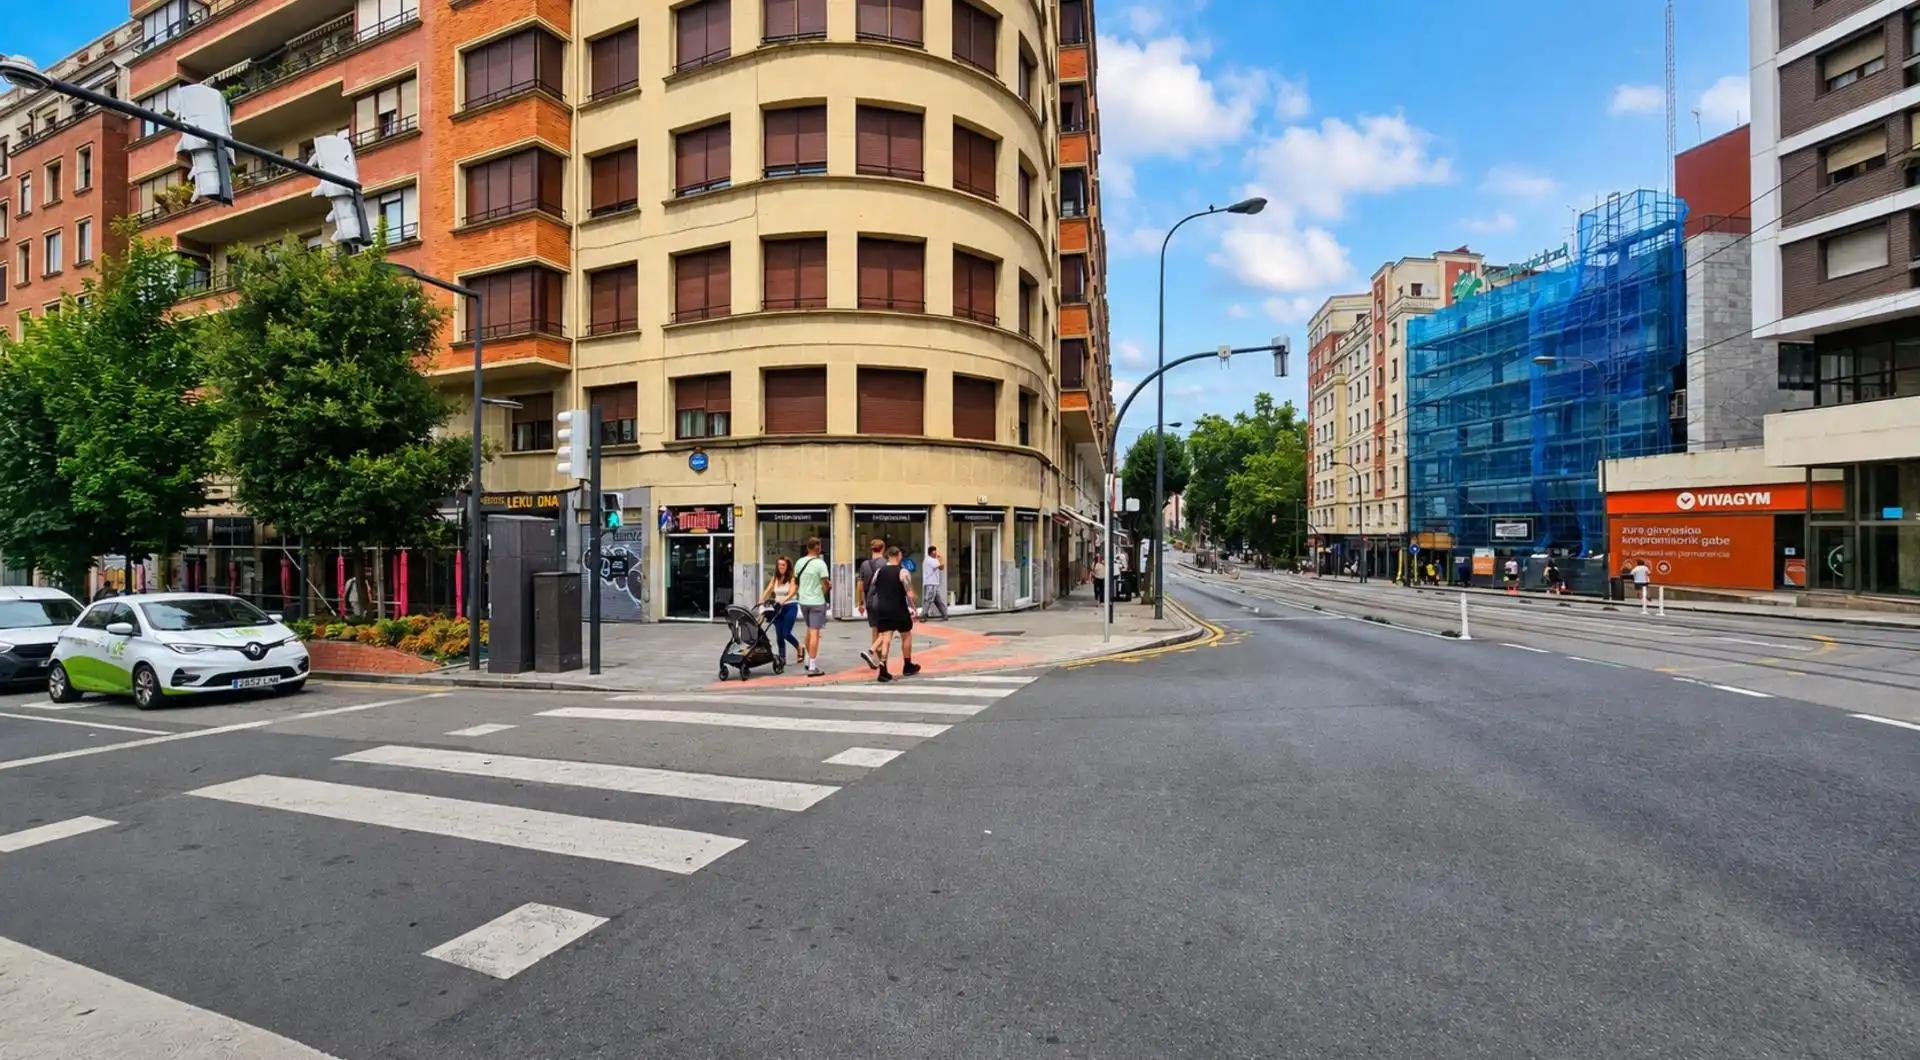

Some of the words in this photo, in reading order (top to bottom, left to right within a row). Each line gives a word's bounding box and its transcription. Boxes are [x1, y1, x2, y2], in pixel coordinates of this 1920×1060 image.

[507, 496, 533, 509] LEKU
[538, 495, 559, 508] ONA
[1697, 492, 1770, 506] VIVAGYM
[1701, 535, 1731, 547] gabe
